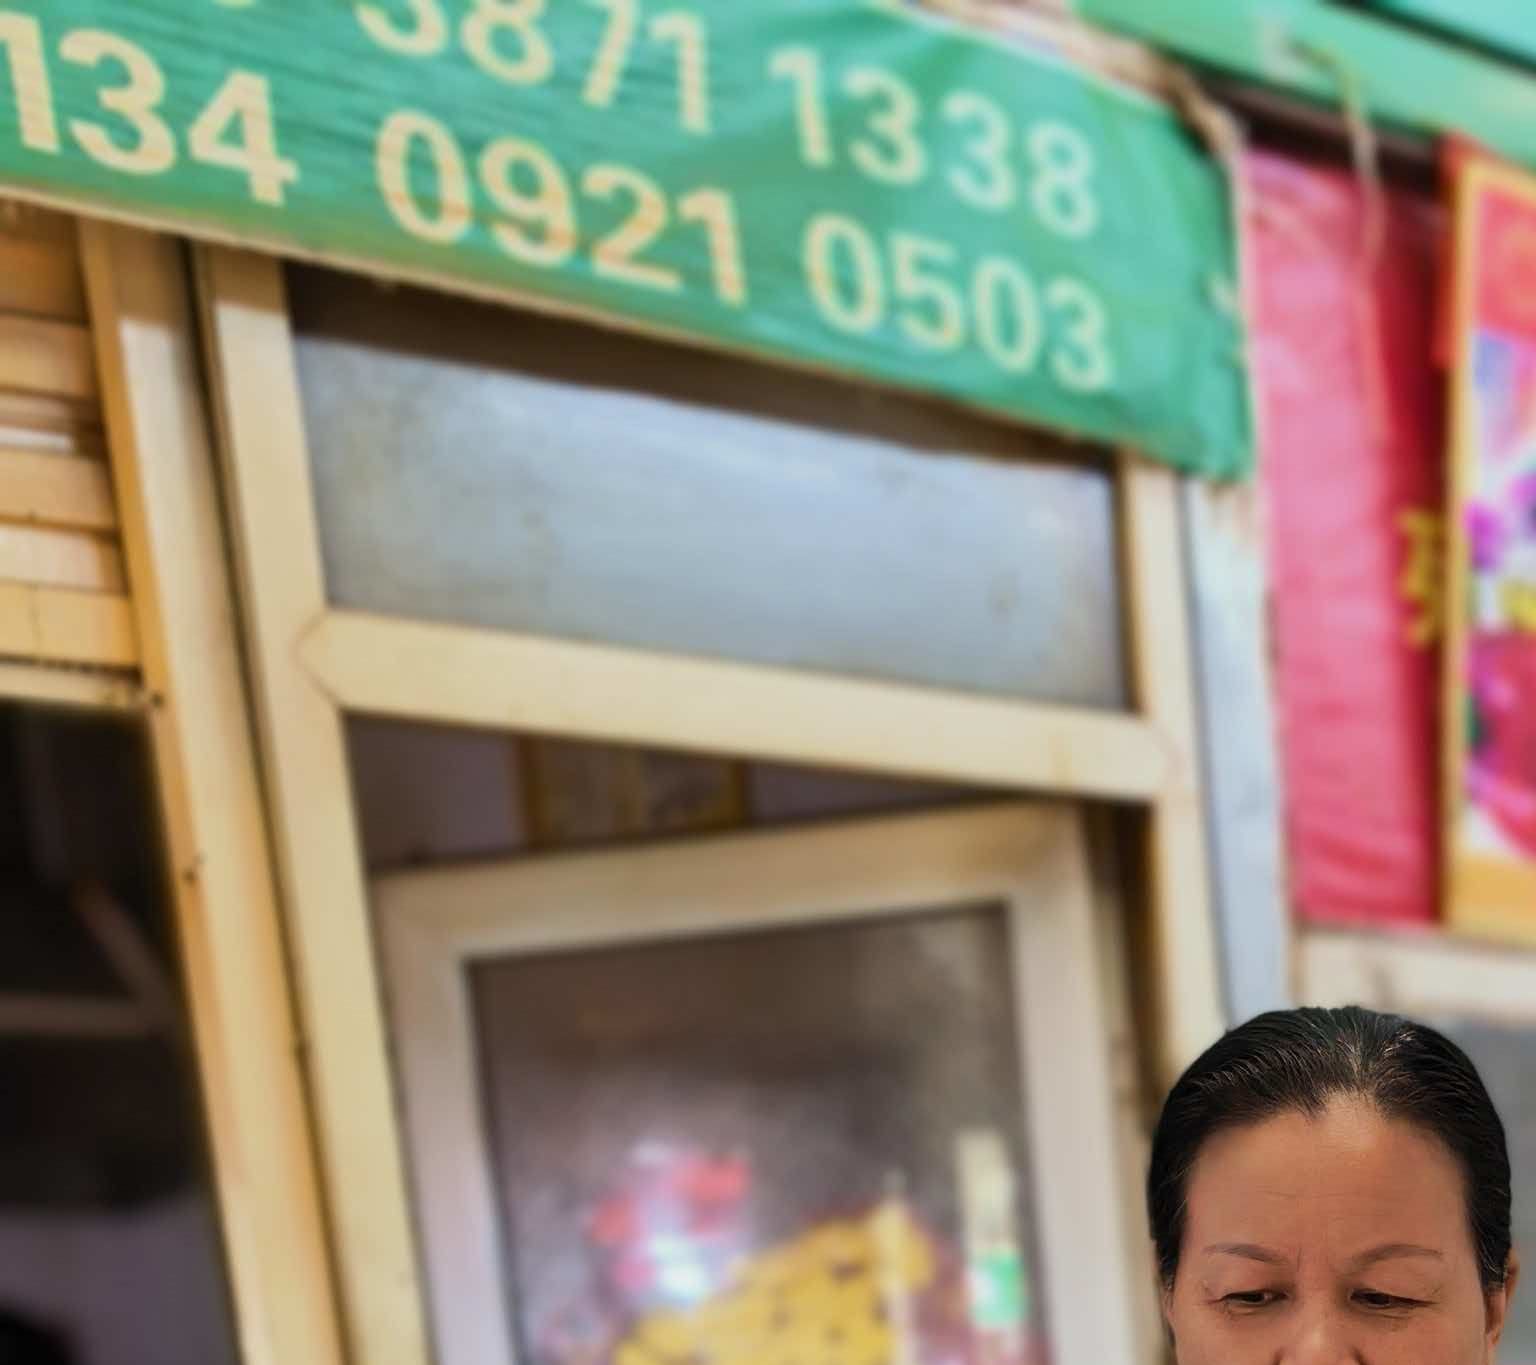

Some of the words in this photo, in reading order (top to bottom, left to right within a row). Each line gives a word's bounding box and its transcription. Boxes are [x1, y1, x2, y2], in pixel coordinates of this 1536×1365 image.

[0, 14, 298, 204] 134
[375, 112, 744, 304] 0921
[804, 215, 1114, 391] 0503
[769, 47, 1100, 238] 1338
